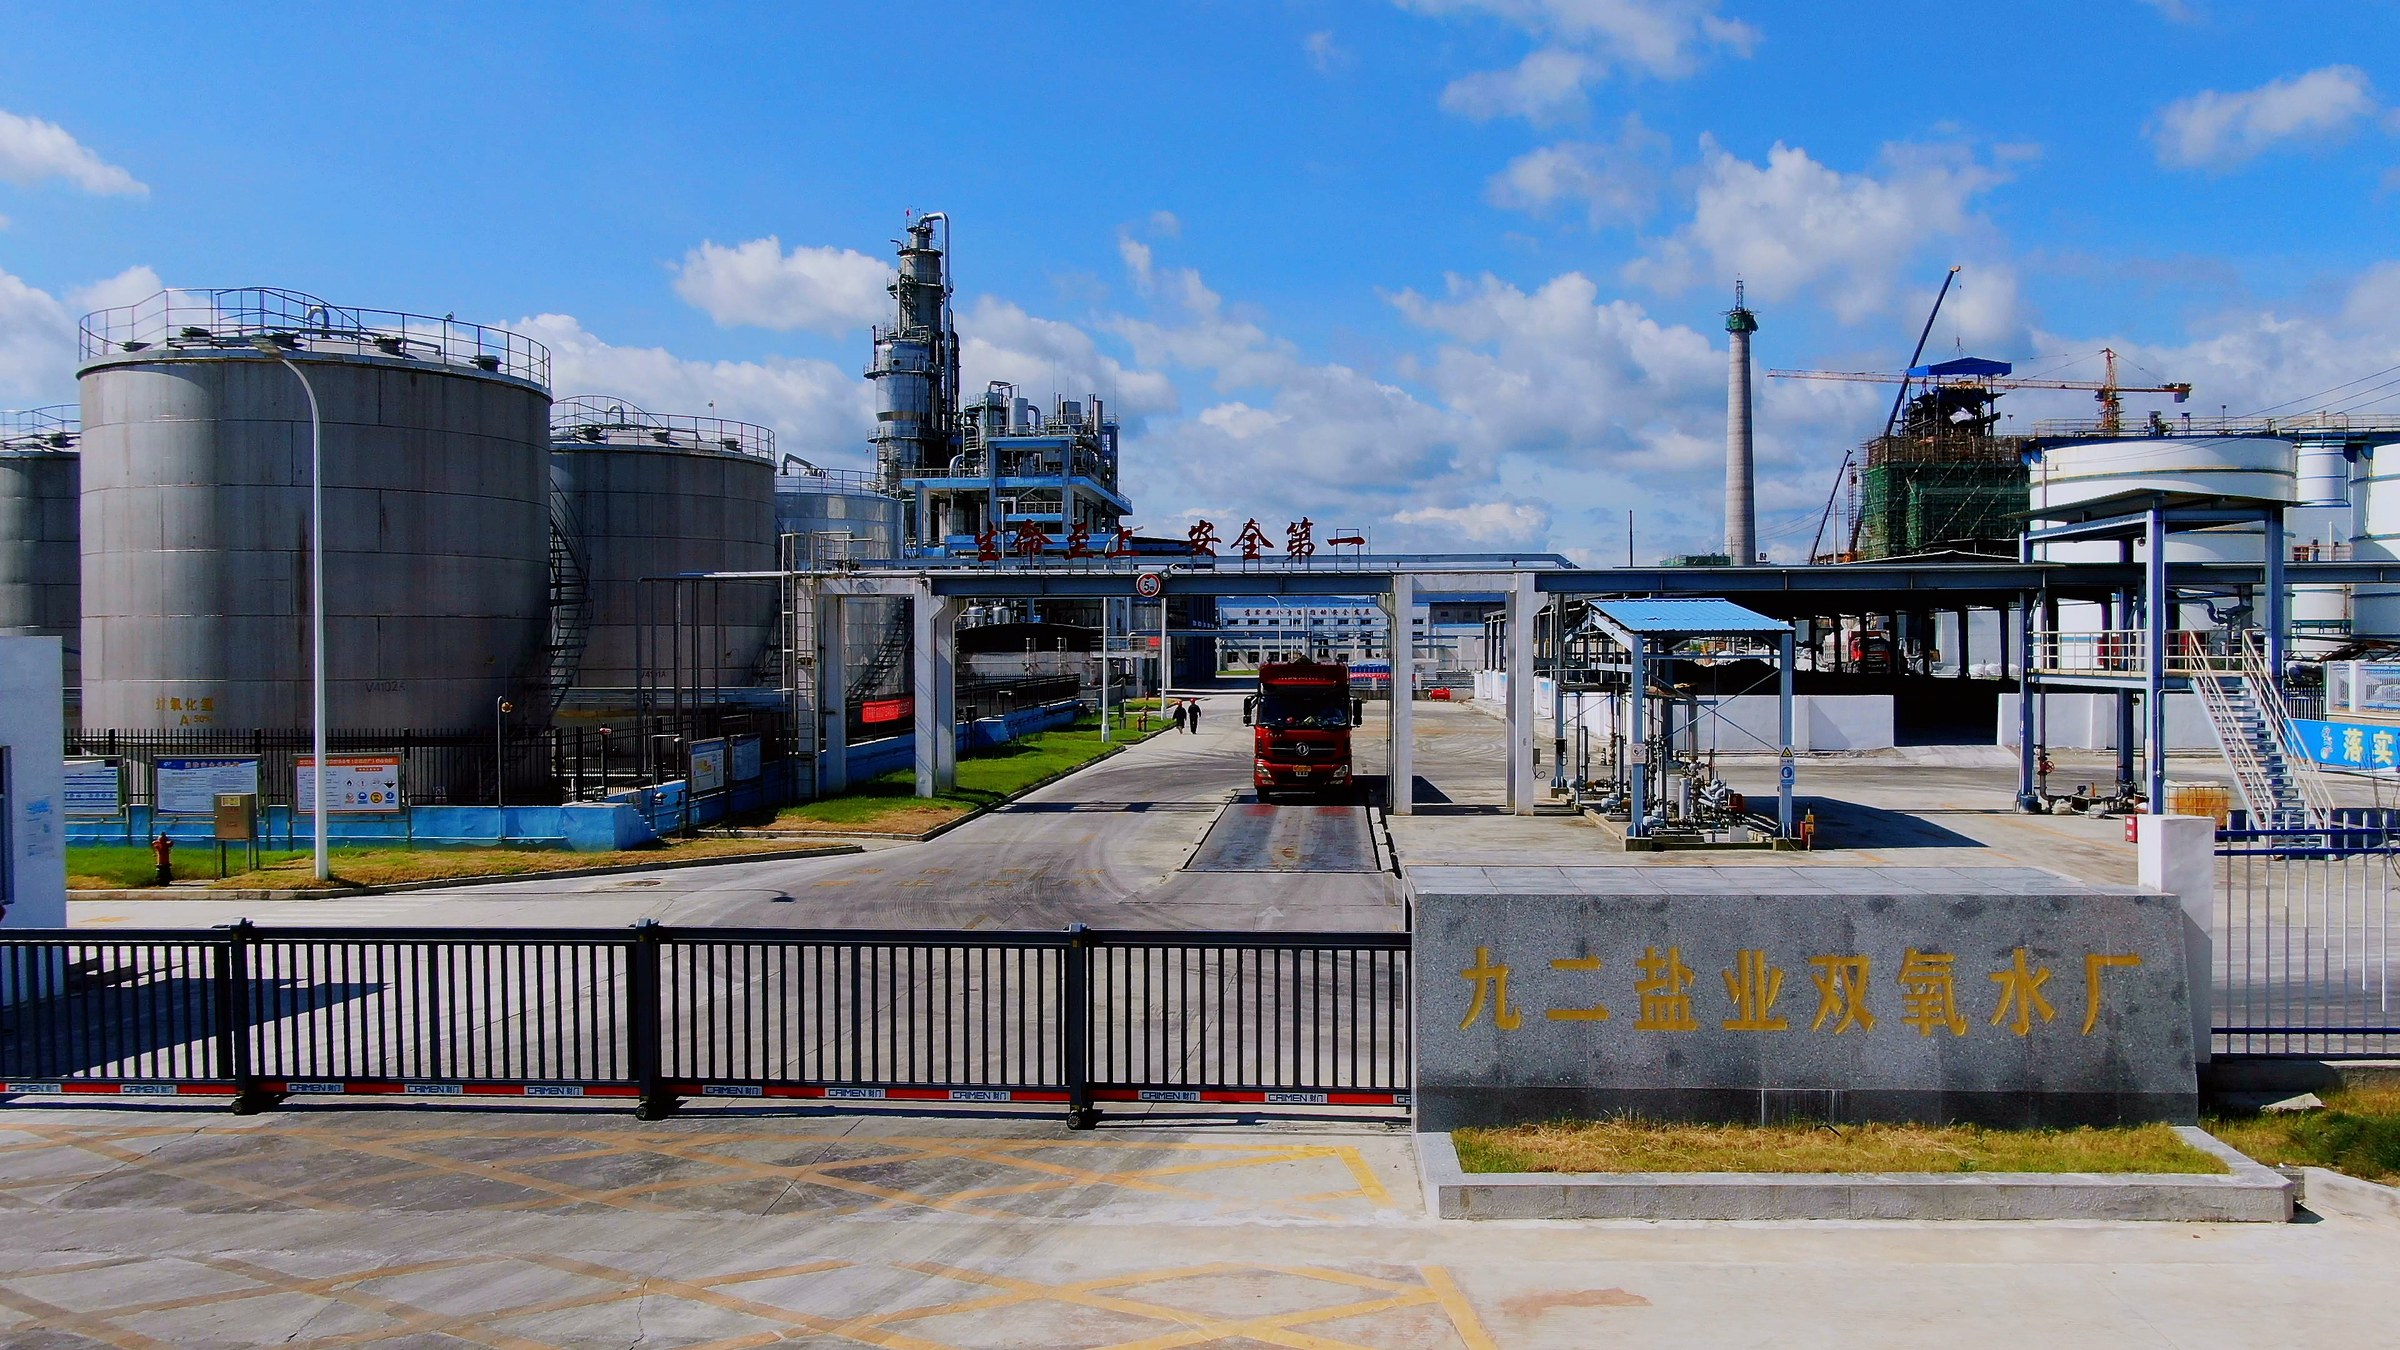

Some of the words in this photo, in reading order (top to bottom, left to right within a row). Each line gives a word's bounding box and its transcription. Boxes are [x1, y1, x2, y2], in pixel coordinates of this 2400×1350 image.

[975, 519, 1140, 569] 生命至上
[1186, 518, 1365, 564] 安全第一
[2342, 727, 2394, 766] 落实
[1458, 945, 2142, 1038] 九二盐业双氧水厂
